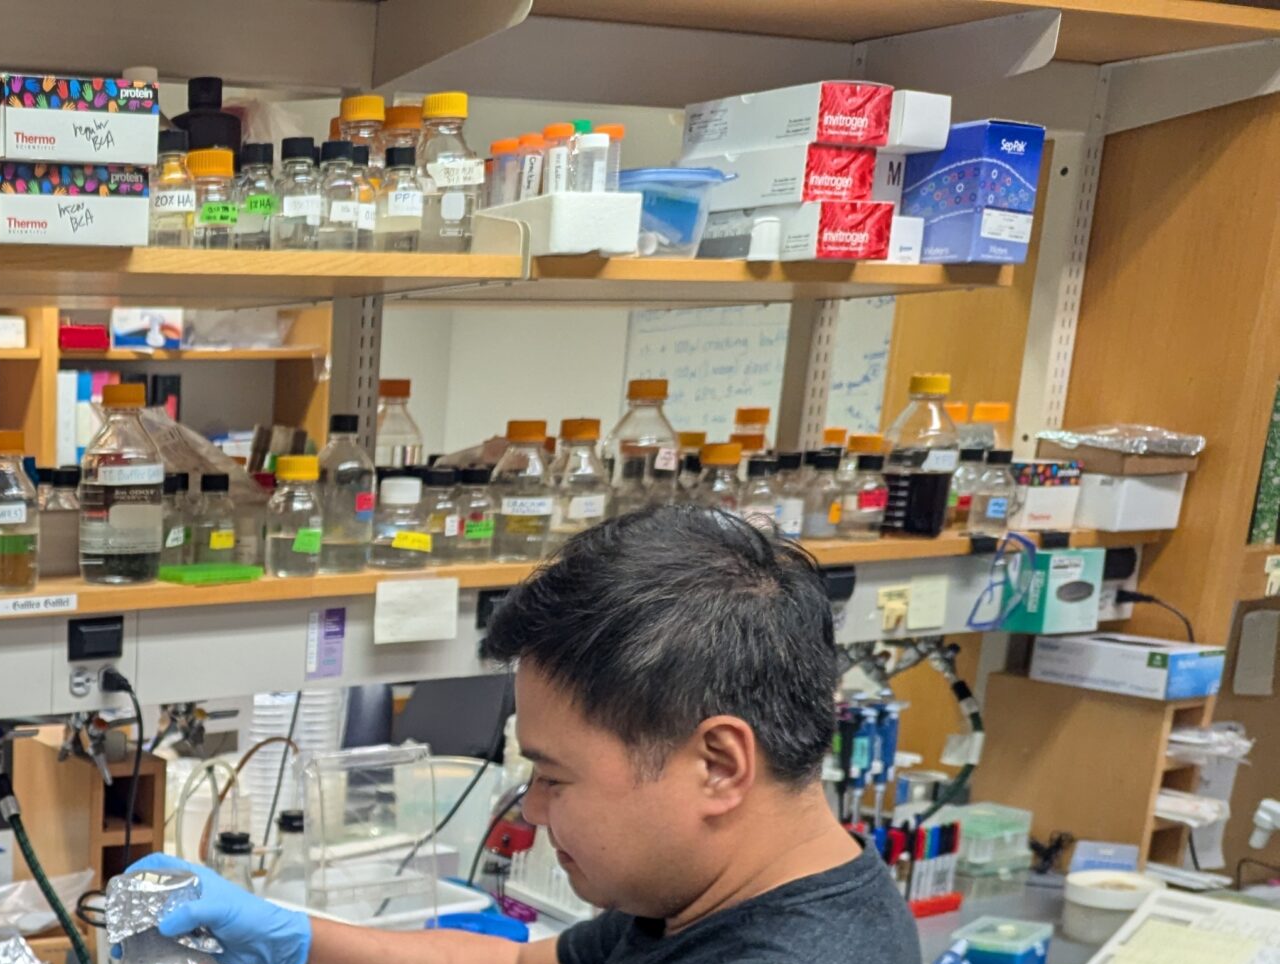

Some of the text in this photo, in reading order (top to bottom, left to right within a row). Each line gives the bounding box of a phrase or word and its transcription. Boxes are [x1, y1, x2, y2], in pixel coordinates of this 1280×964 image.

[120, 87, 153, 99] protein
[824, 111, 869, 128] invitrogen
[14, 131, 56, 145] Thermo
[91, 130, 115, 152] BCA
[110, 172, 143, 183] protein
[809, 174, 853, 191] invitrogen
[6, 217, 48, 230] Thermo
[69, 208, 94, 233] BCA
[823, 227, 869, 244] invitrogen
